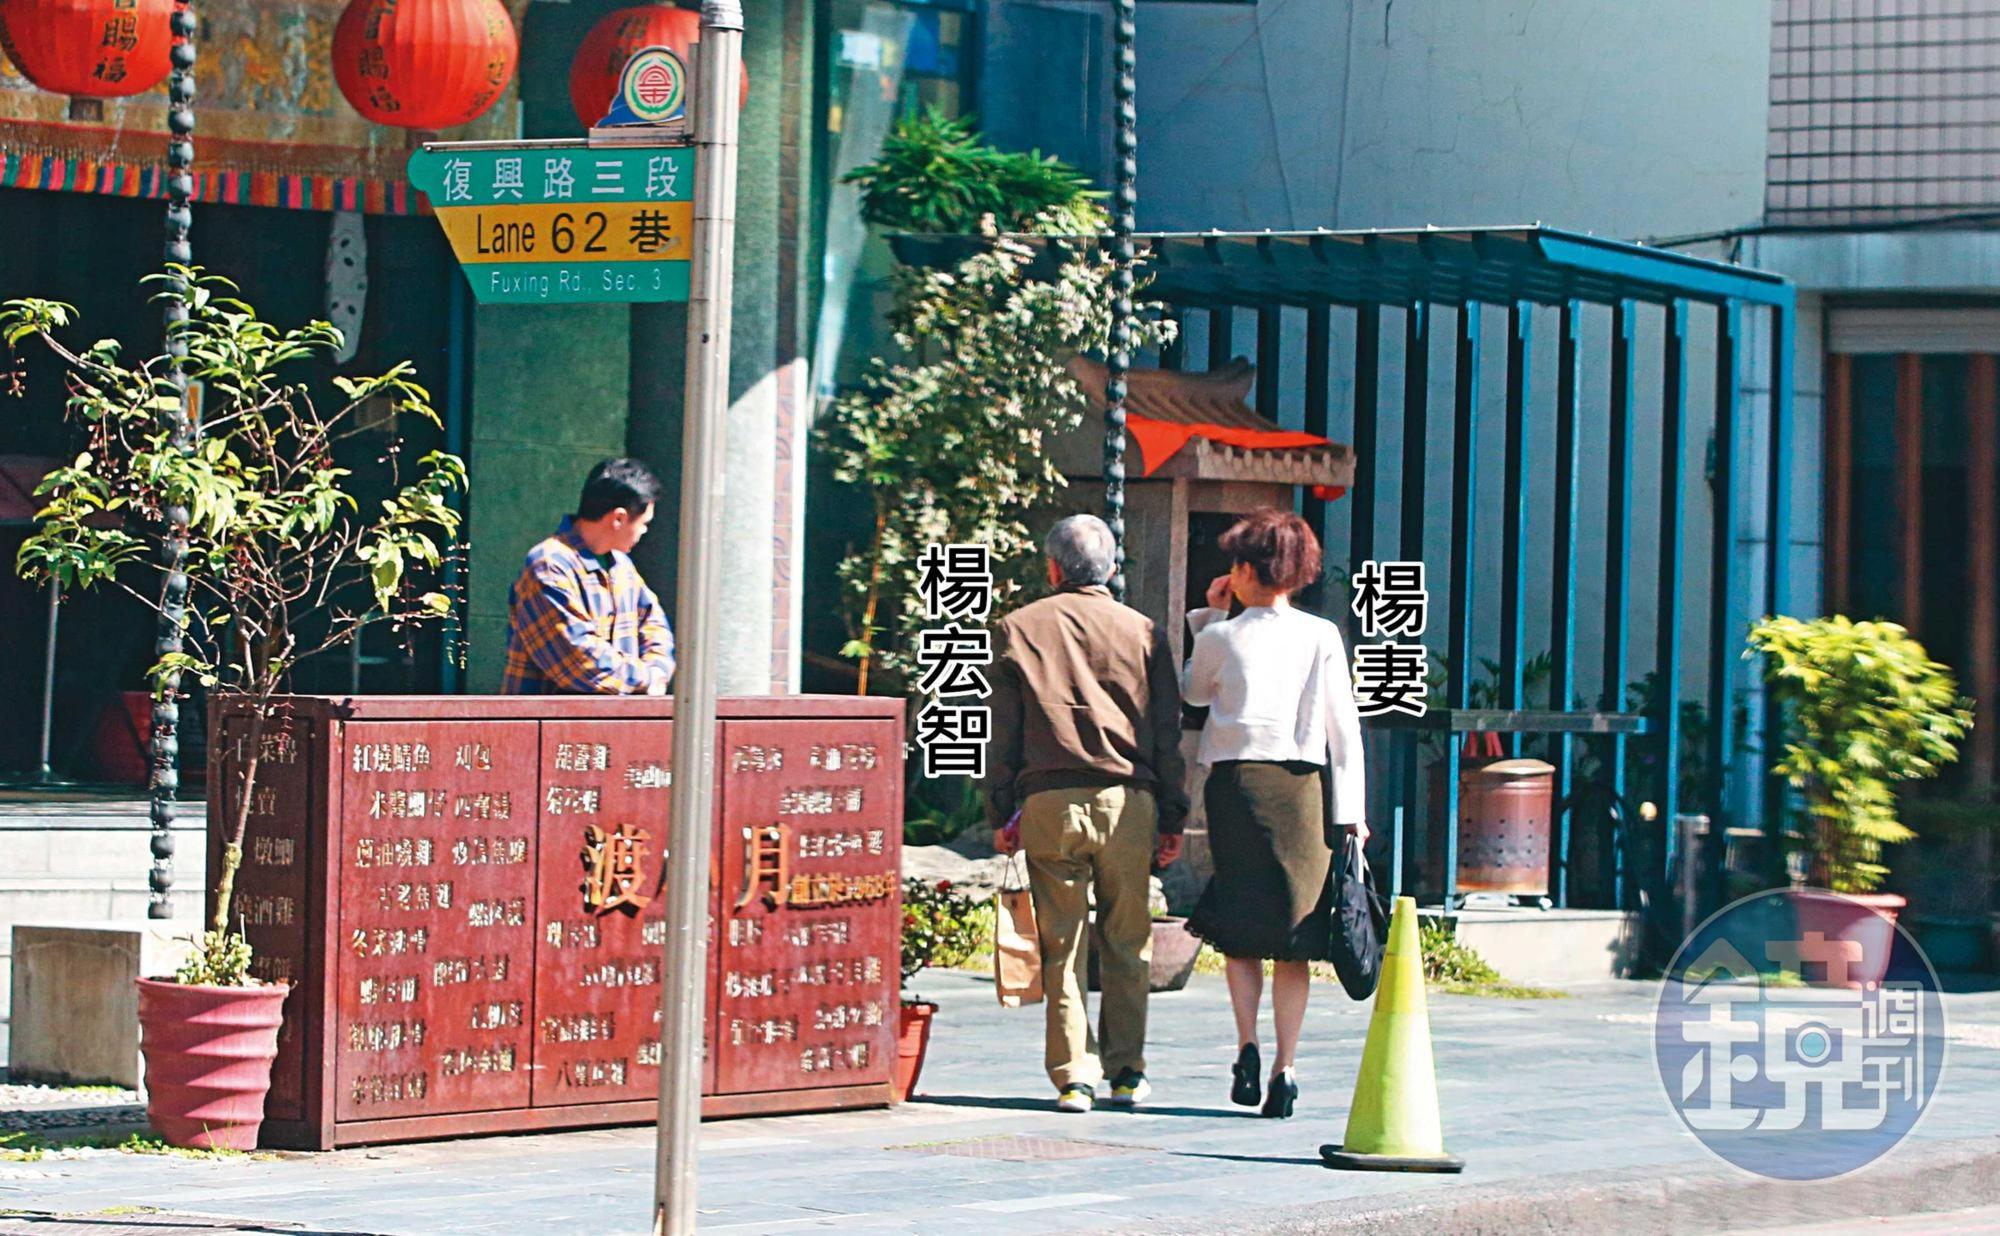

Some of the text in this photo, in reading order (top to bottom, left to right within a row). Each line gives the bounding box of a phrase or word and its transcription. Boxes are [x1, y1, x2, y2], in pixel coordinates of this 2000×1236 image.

[443, 156, 679, 201] 復興路三段
[477, 213, 535, 254] Lane
[551, 211, 608, 254] 62
[491, 271, 549, 298] Fuxing
[652, 267, 662, 291] 3
